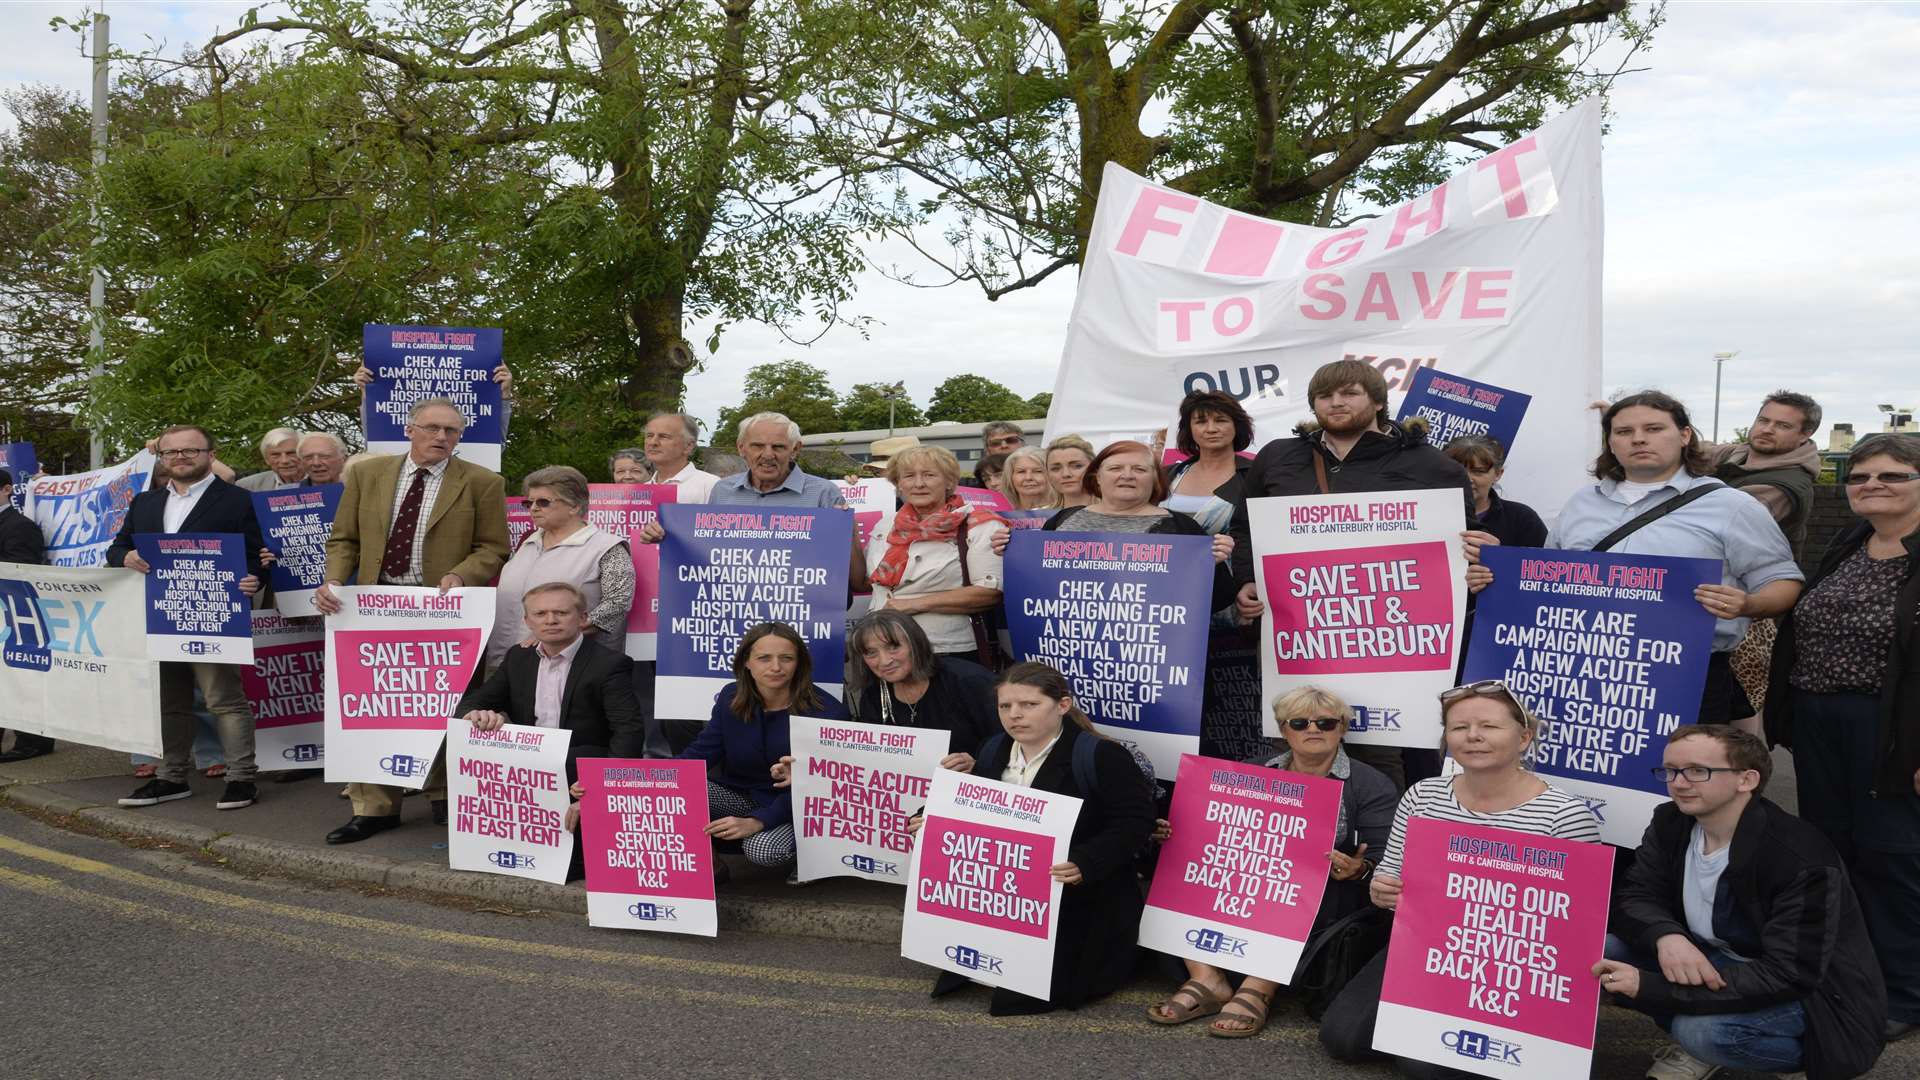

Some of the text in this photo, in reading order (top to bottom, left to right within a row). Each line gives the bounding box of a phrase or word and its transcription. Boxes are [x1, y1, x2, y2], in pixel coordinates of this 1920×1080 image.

[1160, 270, 1514, 342] TO SAVE
[380, 367, 487, 381] CAMPAIGNING FOR
[404, 356, 462, 368] CHEK ARE
[406, 380, 472, 392] NEW ACUTE
[1183, 364, 1283, 401] OUR
[1417, 405, 1489, 436] CHEK WANTS
[34, 480, 76, 495] EAST
[35, 490, 100, 548] NHS
[282, 514, 321, 527] CHEK ARE
[588, 511, 656, 524] BRING OUR
[695, 512, 815, 531] HOSPITAL FIGHT
[1290, 502, 1417, 524] HOSPITAL FIGHT
[1290, 522, 1417, 534] KENT & CANTERBURY HOSPITAL
[710, 548, 792, 566] CHEK ARE
[1044, 541, 1172, 562] HOSPITAL FIGHT
[157, 569, 235, 582] CAMPAIGNING FOR
[174, 560, 215, 570] CHEK ARE
[679, 565, 827, 585] CAMPAIGNING FOR
[1521, 560, 1668, 589] HOSPITAL FIGHT
[36, 582, 102, 592] CONCERN
[177, 581, 224, 591] NEW ACUTE
[1289, 559, 1420, 598] SAVE THE
[165, 590, 229, 601] HOSPITAL WITH
[357, 594, 463, 610] HOSPITAL FIGHT
[712, 584, 805, 603] NEW ACUTE
[1059, 580, 1147, 602] CHEK ARE
[1520, 580, 1663, 602] KENT & CANTERBURY HOSPITAL
[154, 600, 241, 612] MEDICAL SCHOOL IN
[167, 611, 231, 622] THE CENTRE OF
[384, 610, 427, 618] CANTERBURY
[691, 601, 810, 620] HOSPITAL WITH
[1023, 598, 1186, 625] CAMPAIGNING FOR
[1305, 596, 1409, 629] KENT &
[176, 621, 222, 632] EAST KENT
[1059, 620, 1160, 644] NEW ACUTE
[1536, 606, 1637, 636] CHEK ARE
[359, 642, 461, 666] SAVE THE
[1039, 637, 1166, 664] HOSPITAL WITH
[1276, 623, 1451, 661] CANTERBURY
[1494, 624, 1682, 664] CAMPAIGNING FOR
[6, 652, 49, 665] HEALTH
[55, 658, 108, 673] IN EAST KENT
[256, 653, 300, 677] SAVE
[1531, 651, 1650, 685] NEW ACUTE
[267, 674, 313, 697] KENT
[373, 668, 449, 692] KENT &
[342, 693, 462, 718] CANTERBUR
[470, 728, 544, 745] HOSPITAL FIGHT
[820, 727, 916, 748] HOSPITAL FIGHT
[460, 757, 558, 791] MORE ACUTE
[809, 757, 932, 798] MORE ACUTE
[478, 780, 539, 807] MENTAL
[608, 795, 686, 815] BRING OUR
[832, 781, 906, 814] MENTAL
[957, 782, 1048, 815] HOSPITAL FIGHT
[458, 795, 561, 828] HEALTH BEDS
[622, 814, 674, 833] HEALTH
[804, 796, 874, 827] HEALTH
[1205, 800, 1307, 839] BRING OUR
[457, 814, 562, 847] IN EAST KENT
[615, 832, 685, 852] SERVICES
[804, 817, 875, 845] IN EAST
[1218, 825, 1286, 857] HEALTH
[608, 850, 696, 872] BACK TO THE
[941, 831, 1032, 871] SAVE THE
[1202, 844, 1294, 880] SERVICES
[1450, 835, 1568, 869] HOSPITAL FIGHT
[949, 858, 1018, 895] KENT &
[1447, 852, 1565, 880] KENT & CANTERBURY HOSPITAL
[638, 870, 668, 888] K&C
[1184, 862, 1301, 906] BACK TO THE
[920, 878, 1048, 926] CANTERBURY
[1213, 890, 1256, 918] K&C
[1446, 873, 1570, 920] BRING OUR
[1463, 903, 1547, 941] HEALTH
[1445, 926, 1558, 971] SERVICES
[1425, 948, 1571, 1003] BACK TO THE
[1468, 984, 1520, 1018] K&C
